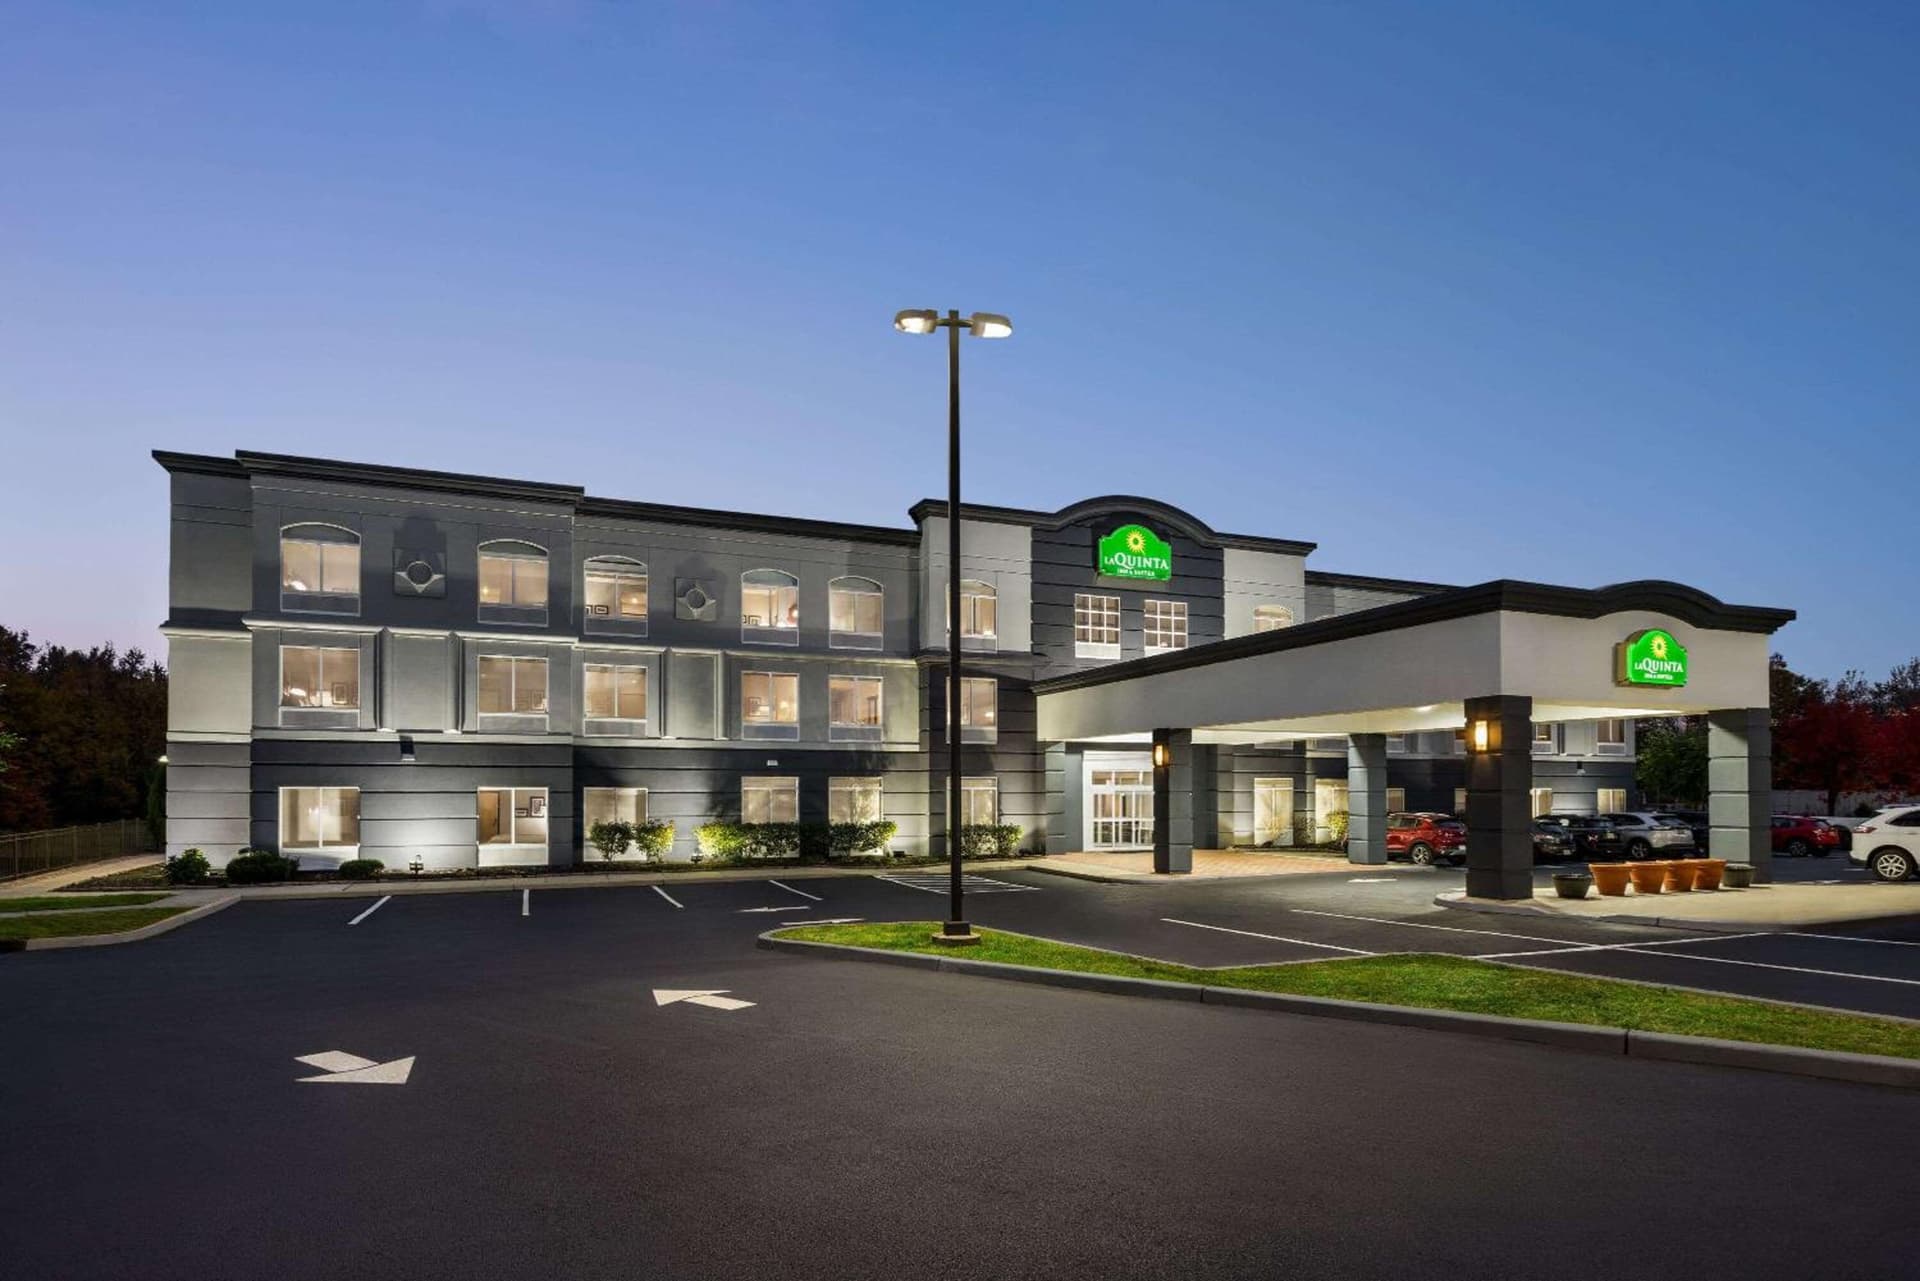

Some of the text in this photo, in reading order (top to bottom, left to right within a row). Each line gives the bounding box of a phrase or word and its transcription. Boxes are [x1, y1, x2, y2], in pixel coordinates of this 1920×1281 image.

[1104, 552, 1169, 570] LA QUINTA
[1634, 657, 1684, 673] LA QUINTA
